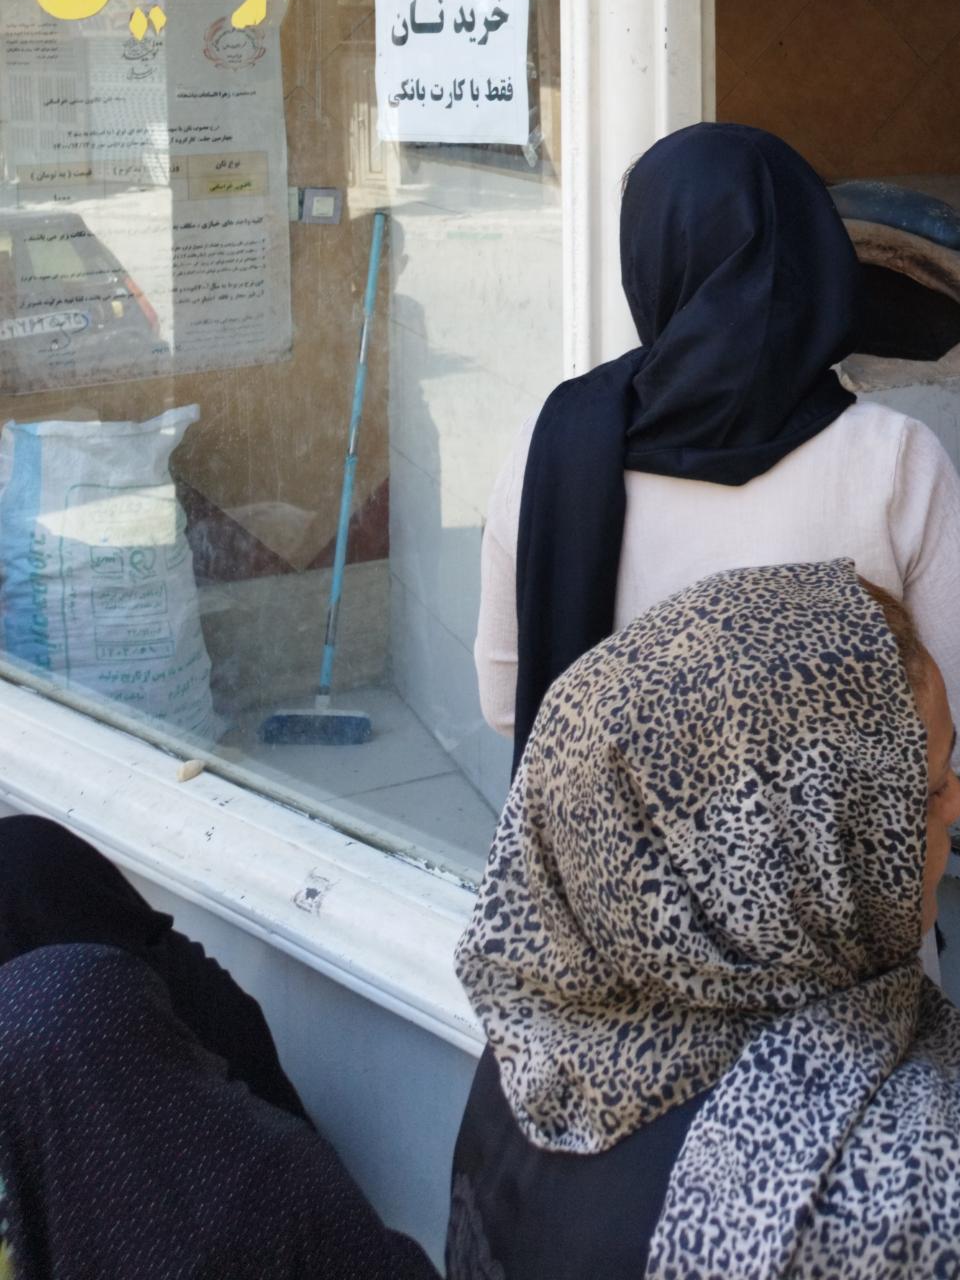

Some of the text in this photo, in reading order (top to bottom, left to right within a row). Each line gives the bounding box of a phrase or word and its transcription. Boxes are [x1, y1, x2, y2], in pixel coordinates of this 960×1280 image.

[388, 76, 514, 109] فقط با کارت بانکی
